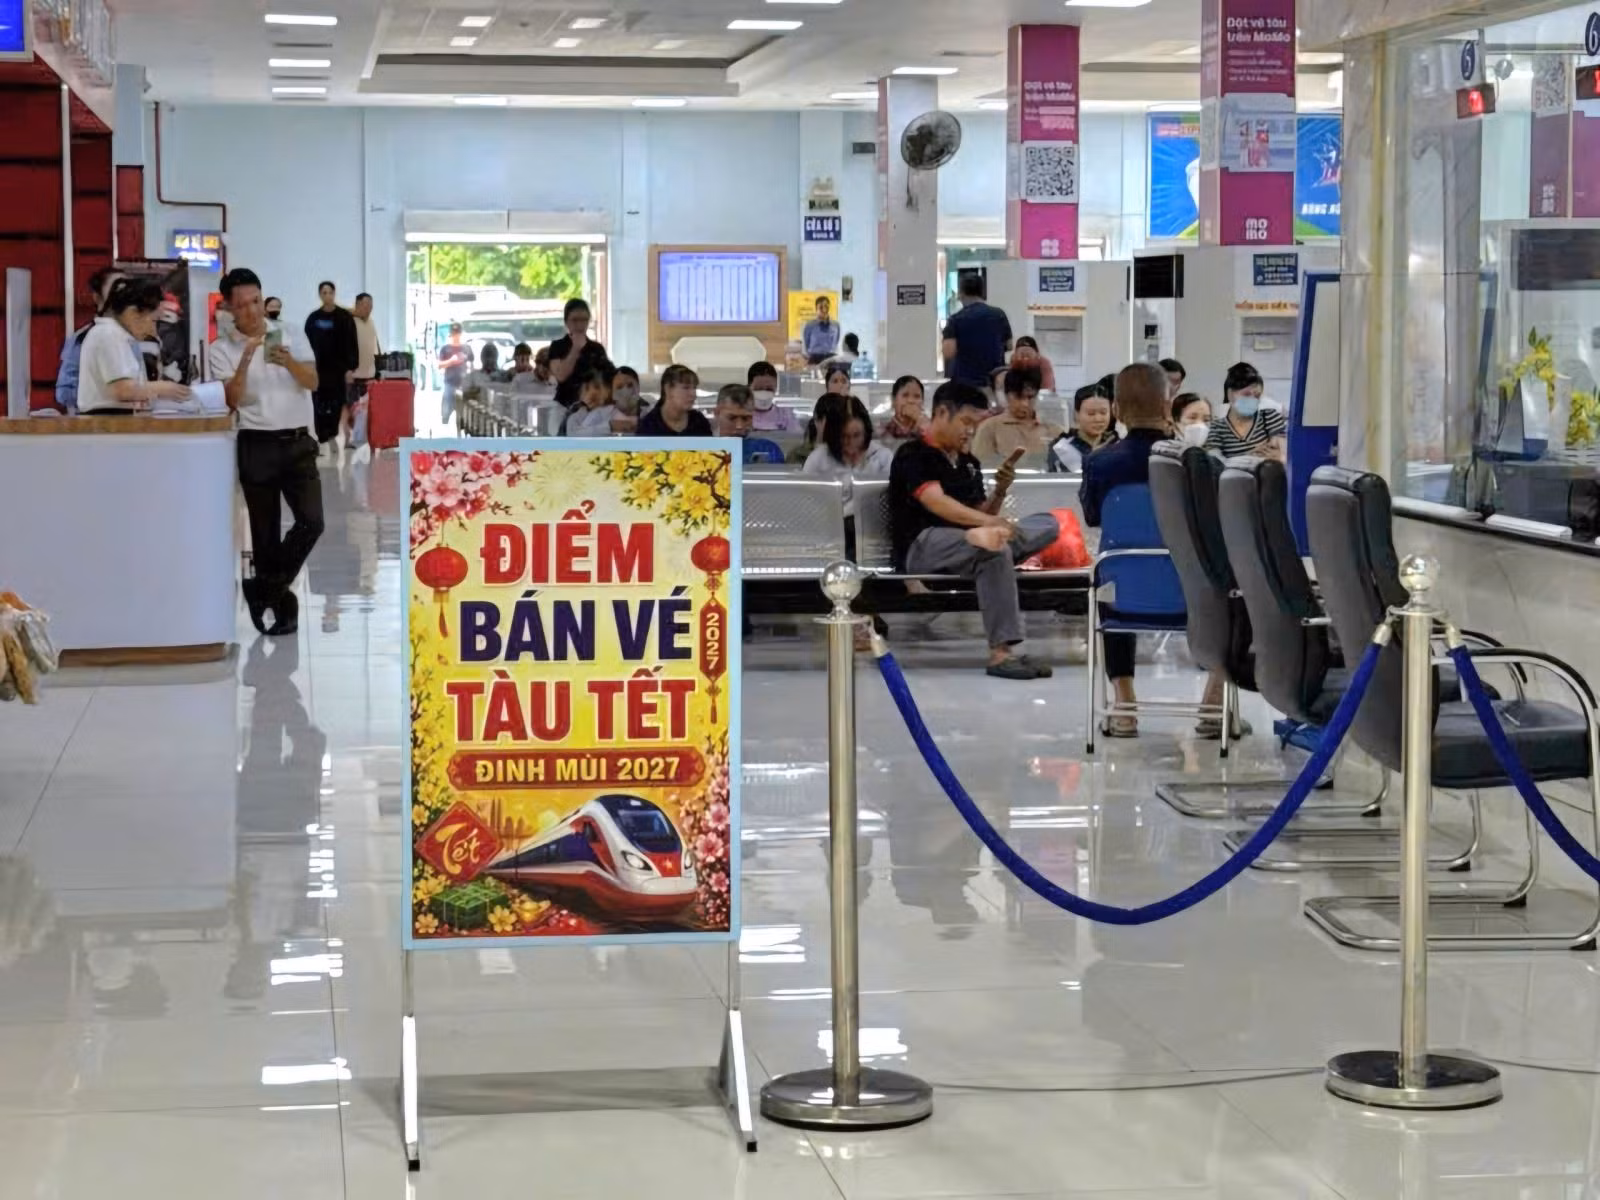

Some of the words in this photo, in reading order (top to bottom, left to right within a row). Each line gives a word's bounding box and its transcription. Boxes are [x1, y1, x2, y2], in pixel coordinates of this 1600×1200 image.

[1588, 14, 1598, 54] 6
[479, 499, 654, 585] ĐIỂM
[460, 589, 596, 661] BÁN
[612, 585, 692, 660] VÉ
[705, 612, 720, 670] 2027
[446, 669, 571, 742] TÀU
[587, 665, 697, 741] TẾT
[475, 758, 545, 783] ĐINH
[555, 752, 607, 782] MÙI
[616, 756, 680, 781] 2027
[435, 821, 481, 876] Tết
